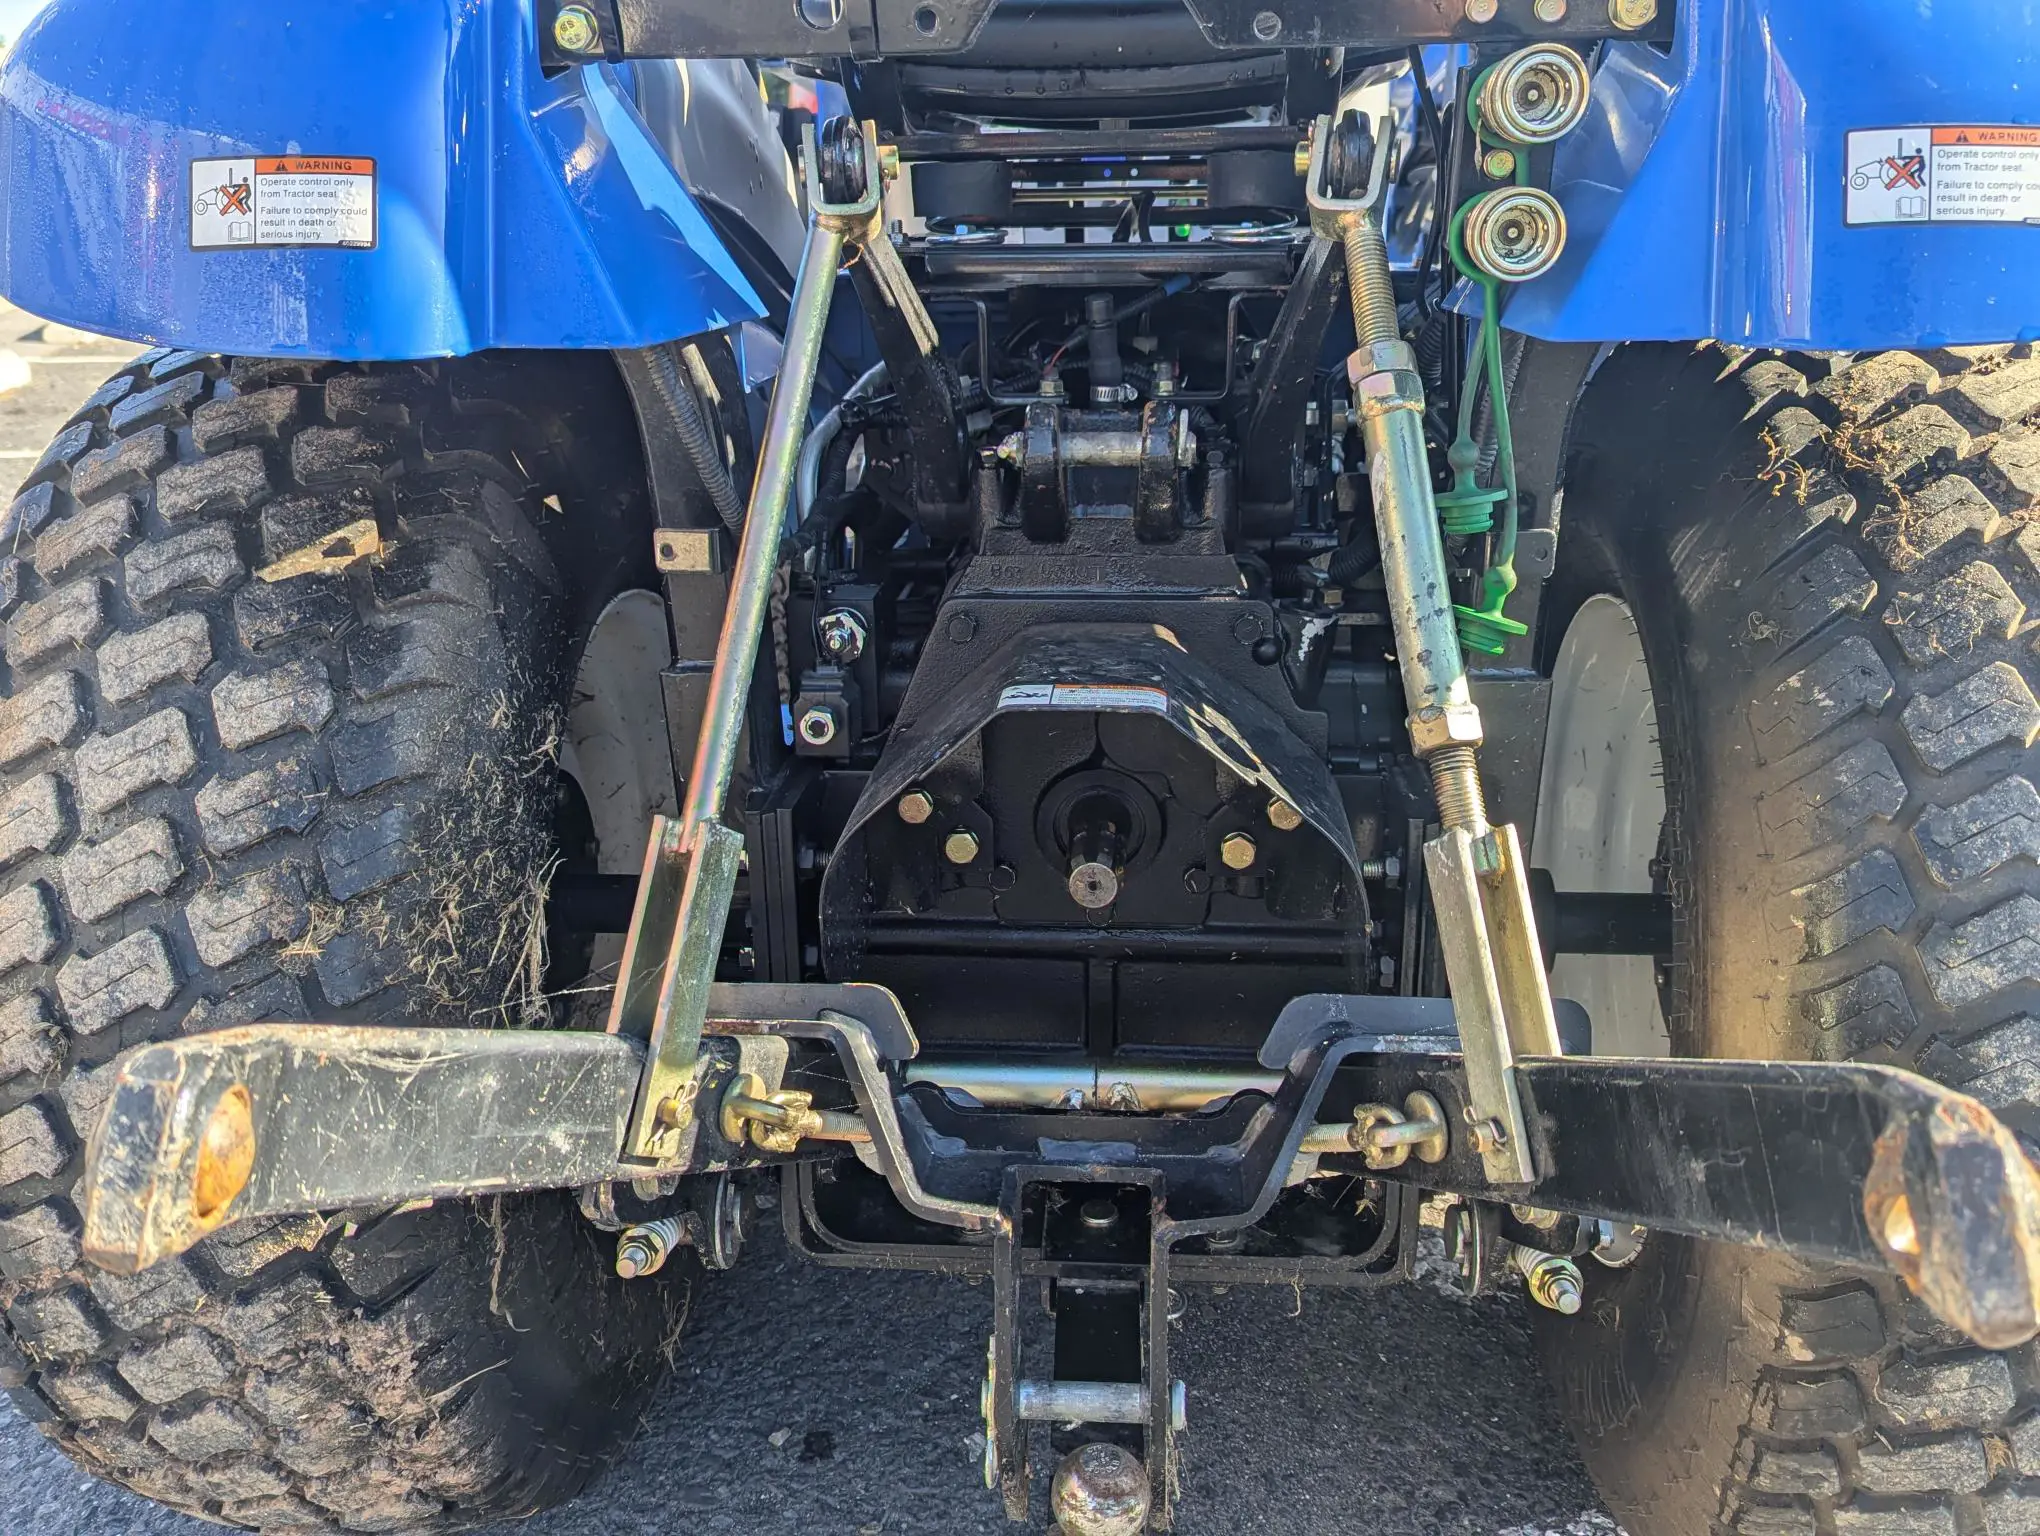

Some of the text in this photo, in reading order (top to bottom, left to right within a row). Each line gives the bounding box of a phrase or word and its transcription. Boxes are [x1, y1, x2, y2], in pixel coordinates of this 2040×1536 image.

[1978, 132, 2038, 143] WARNING
[1937, 149, 2040, 161] Operate control only
[295, 160, 352, 171] WARNING
[1937, 162, 1961, 171] from
[1963, 162, 1999, 172] Tractor
[260, 177, 354, 188] Operate control only
[1936, 180, 1972, 190] Failure
[1974, 180, 1985, 190] to
[1987, 181, 2024, 191] comply
[260, 190, 282, 198] from
[283, 190, 315, 198] Tractor
[1936, 193, 1966, 202] result
[1968, 194, 1978, 202] in
[1980, 194, 2008, 203] death
[260, 206, 368, 216] Failure to comply could
[1936, 206, 1974, 215] serious
[260, 219, 337, 227] result in death or
[260, 230, 294, 239] serious
